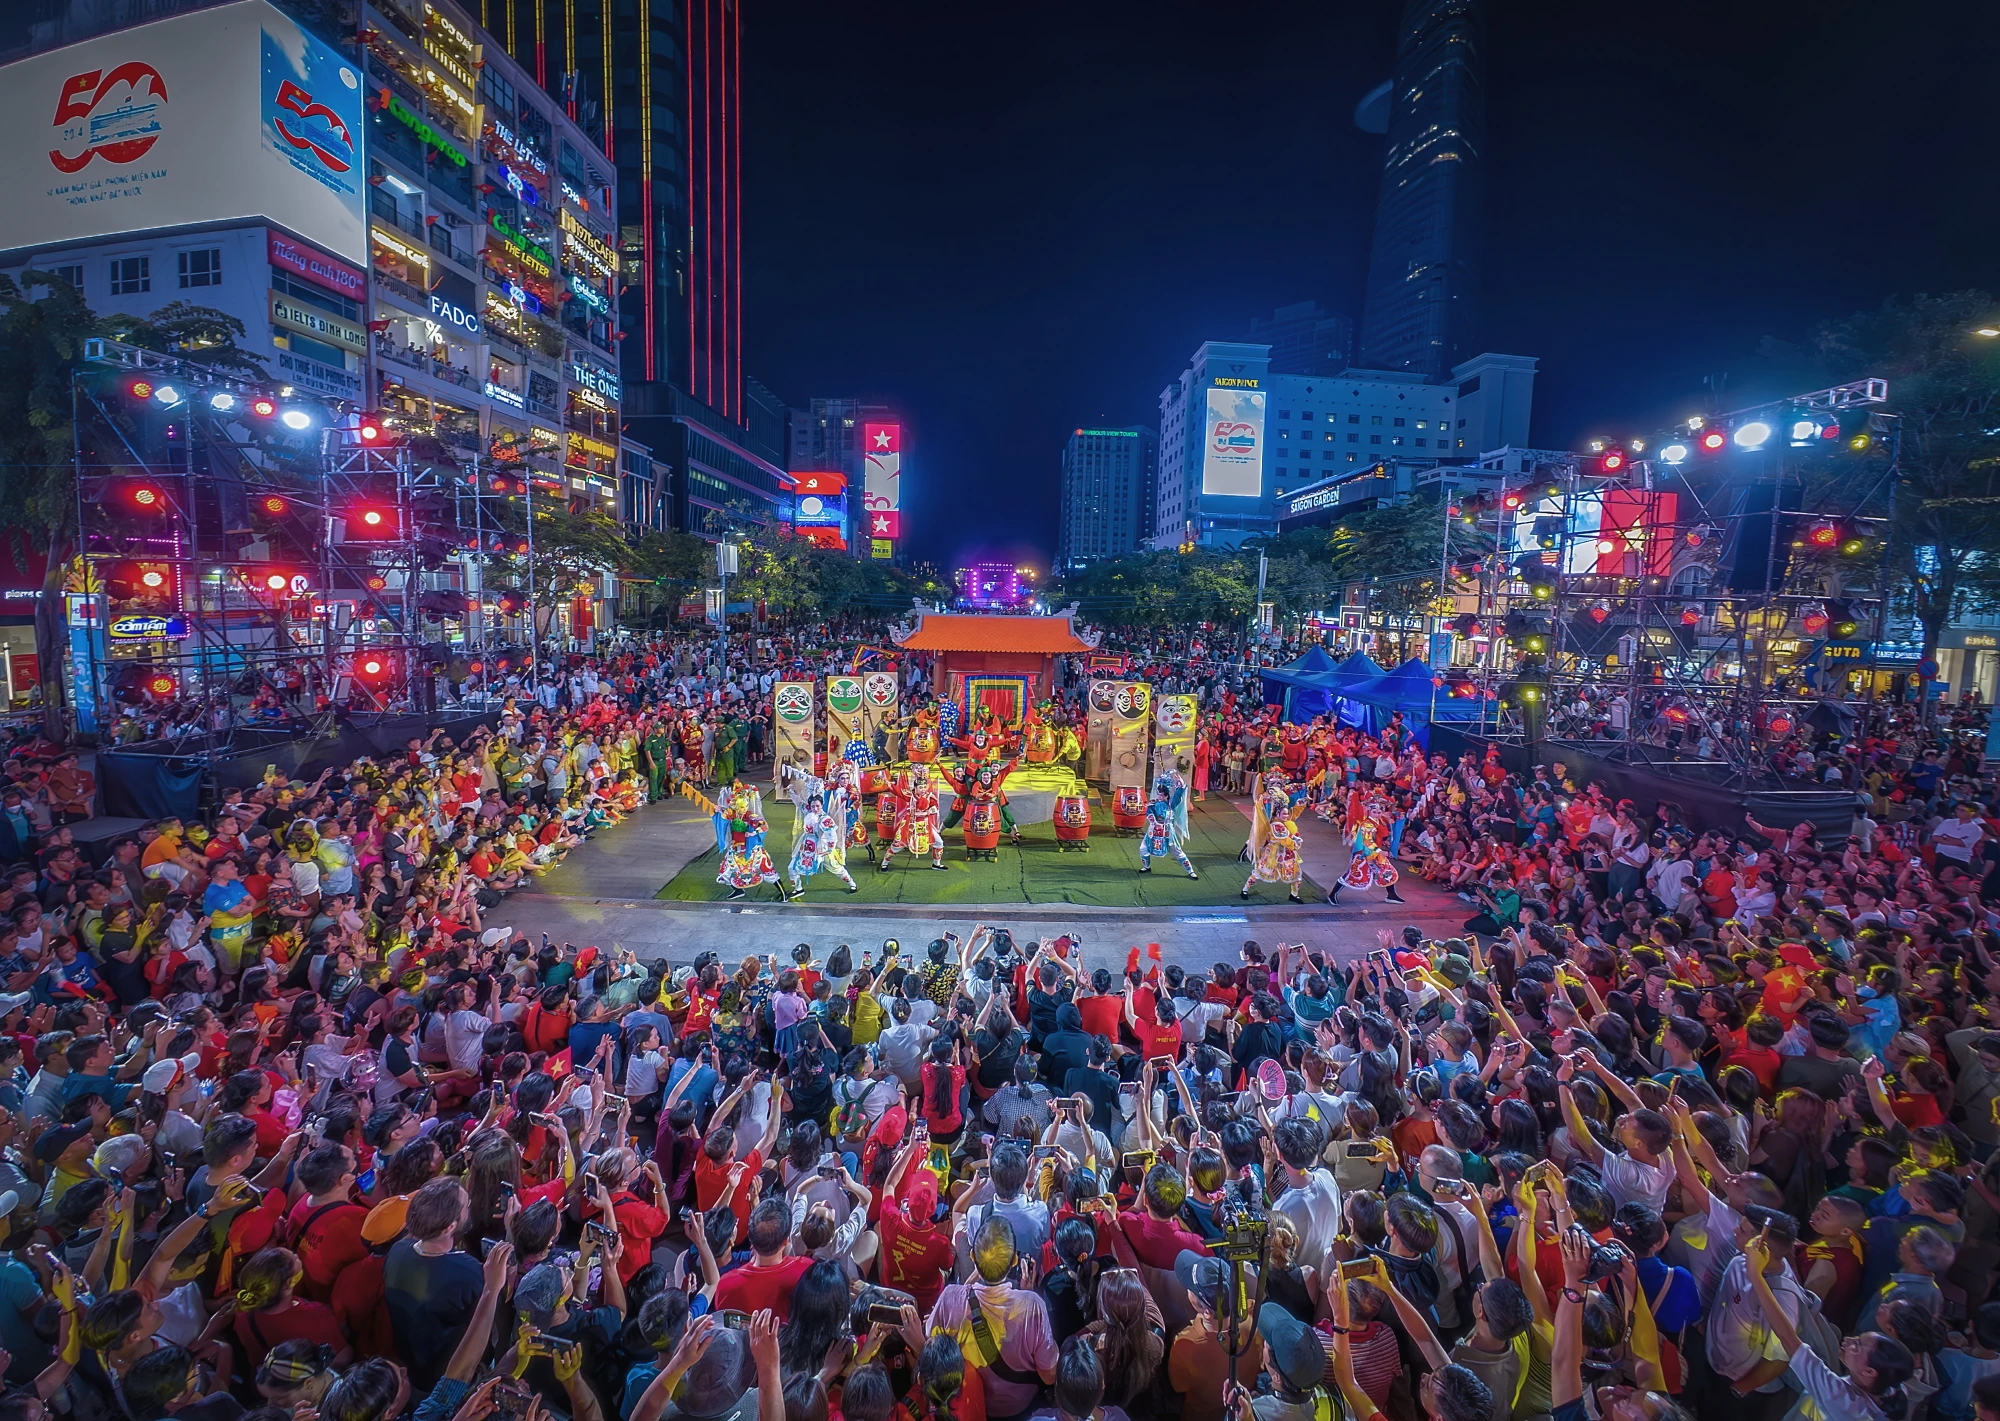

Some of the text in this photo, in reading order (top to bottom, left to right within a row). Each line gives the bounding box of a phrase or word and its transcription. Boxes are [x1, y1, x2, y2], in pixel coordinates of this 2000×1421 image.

[290, 308, 316, 328] IELTS
[574, 365, 596, 389] THE
[597, 378, 619, 401] ONE
[1290, 489, 1340, 514] SAIGON GARDEN
